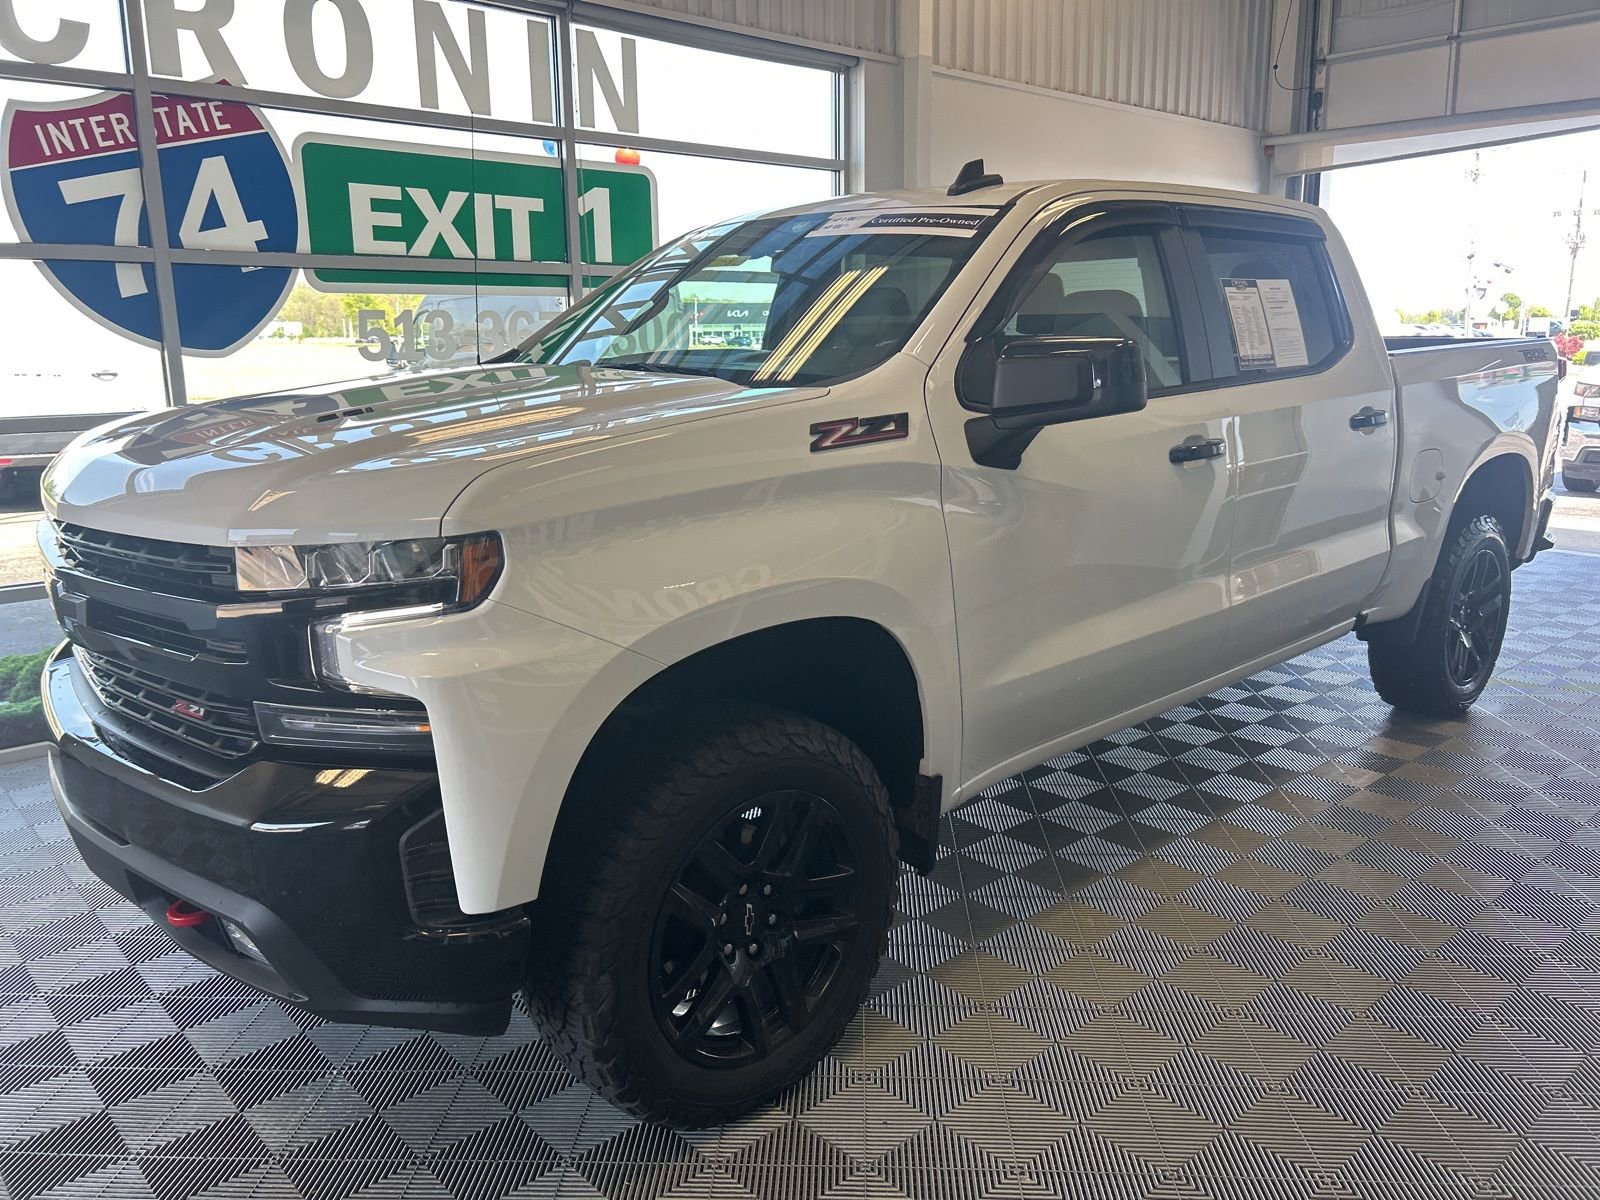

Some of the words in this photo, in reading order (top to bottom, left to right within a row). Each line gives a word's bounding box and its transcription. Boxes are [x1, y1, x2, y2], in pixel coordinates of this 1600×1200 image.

[34, 101, 231, 156] INTERTATE
[57, 155, 269, 298] 74
[348, 182, 545, 262] EXIT
[577, 187, 613, 263] 1
[871, 216, 916, 225] Certified
[917, 217, 979, 226] Pre-Owned
[810, 412, 908, 452] Z71
[171, 699, 206, 720] Z71
